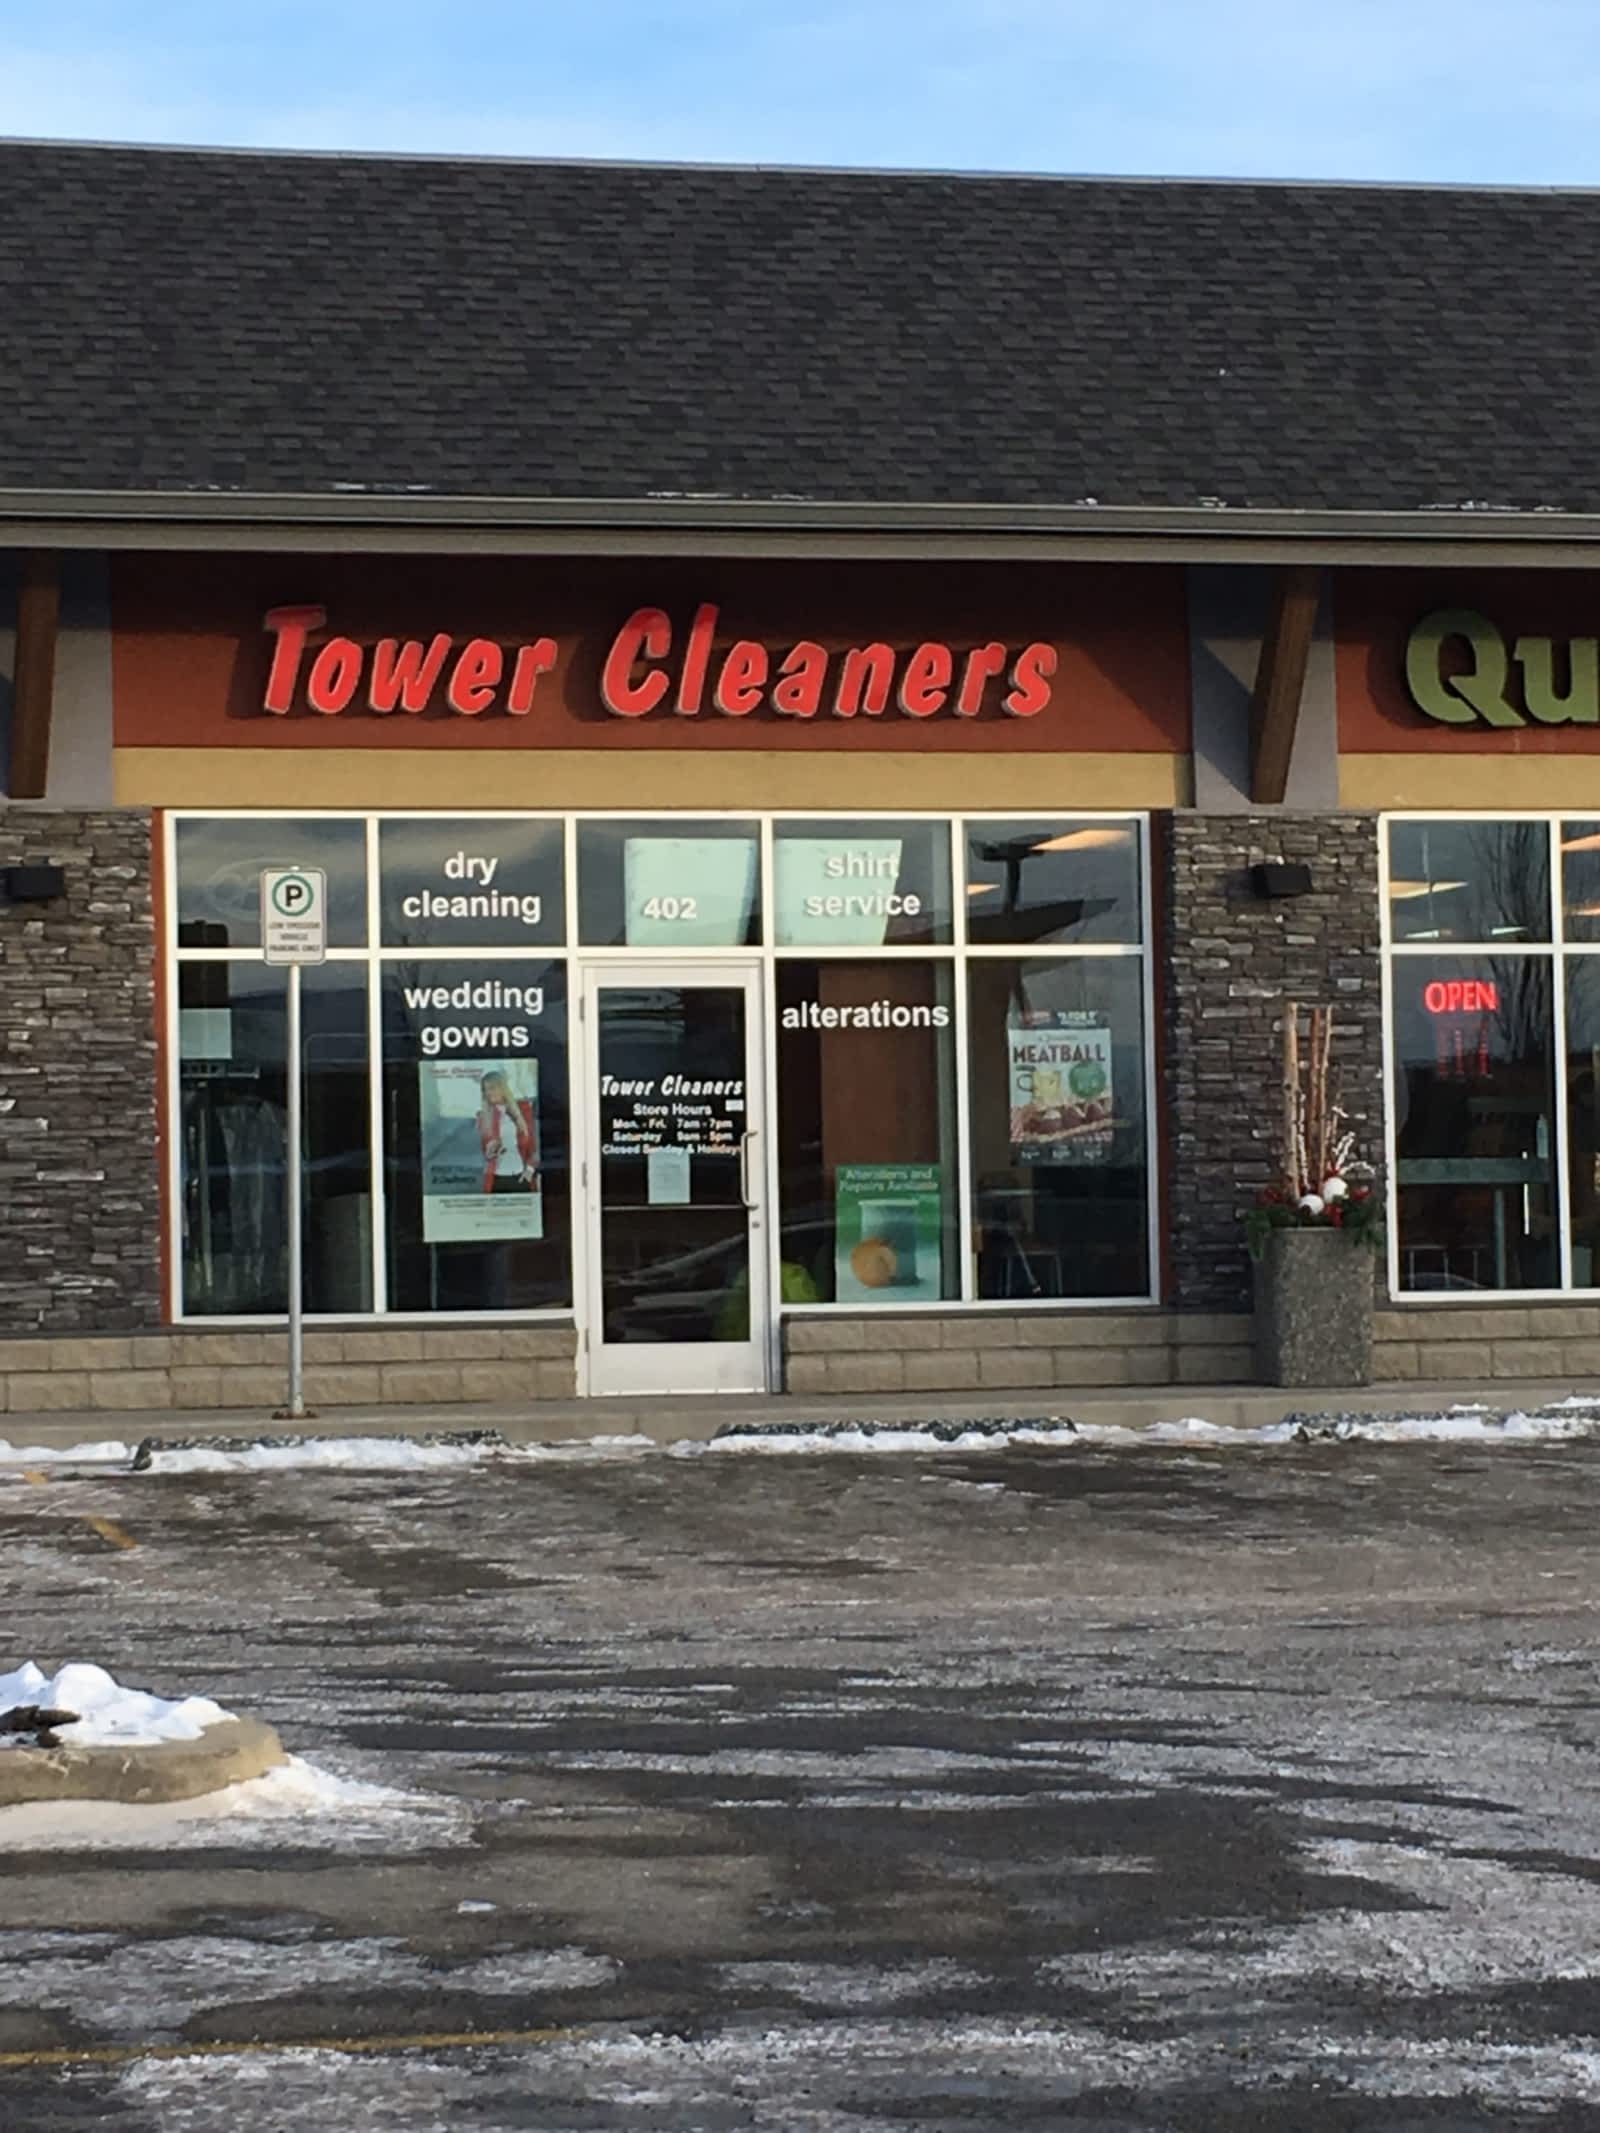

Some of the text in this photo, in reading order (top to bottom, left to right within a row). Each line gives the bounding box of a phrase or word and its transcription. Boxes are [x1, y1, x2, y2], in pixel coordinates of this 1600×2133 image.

[263, 603, 1058, 718] Tower Cleaners
[444, 851, 498, 885] dry
[826, 852, 900, 878] shirt
[285, 885, 303, 907] P
[403, 890, 541, 924] cleaning
[644, 897, 697, 920] 402
[806, 893, 921, 917] service
[404, 981, 544, 1015] wedding
[1424, 981, 1498, 1013] OPEN
[782, 1001, 950, 1029] alterations
[421, 1025, 530, 1054] gowns
[1013, 1044, 1106, 1063] MEATBALL
[601, 1074, 743, 1096] Tower Cleaners
[633, 1103, 712, 1116] Store Hours
